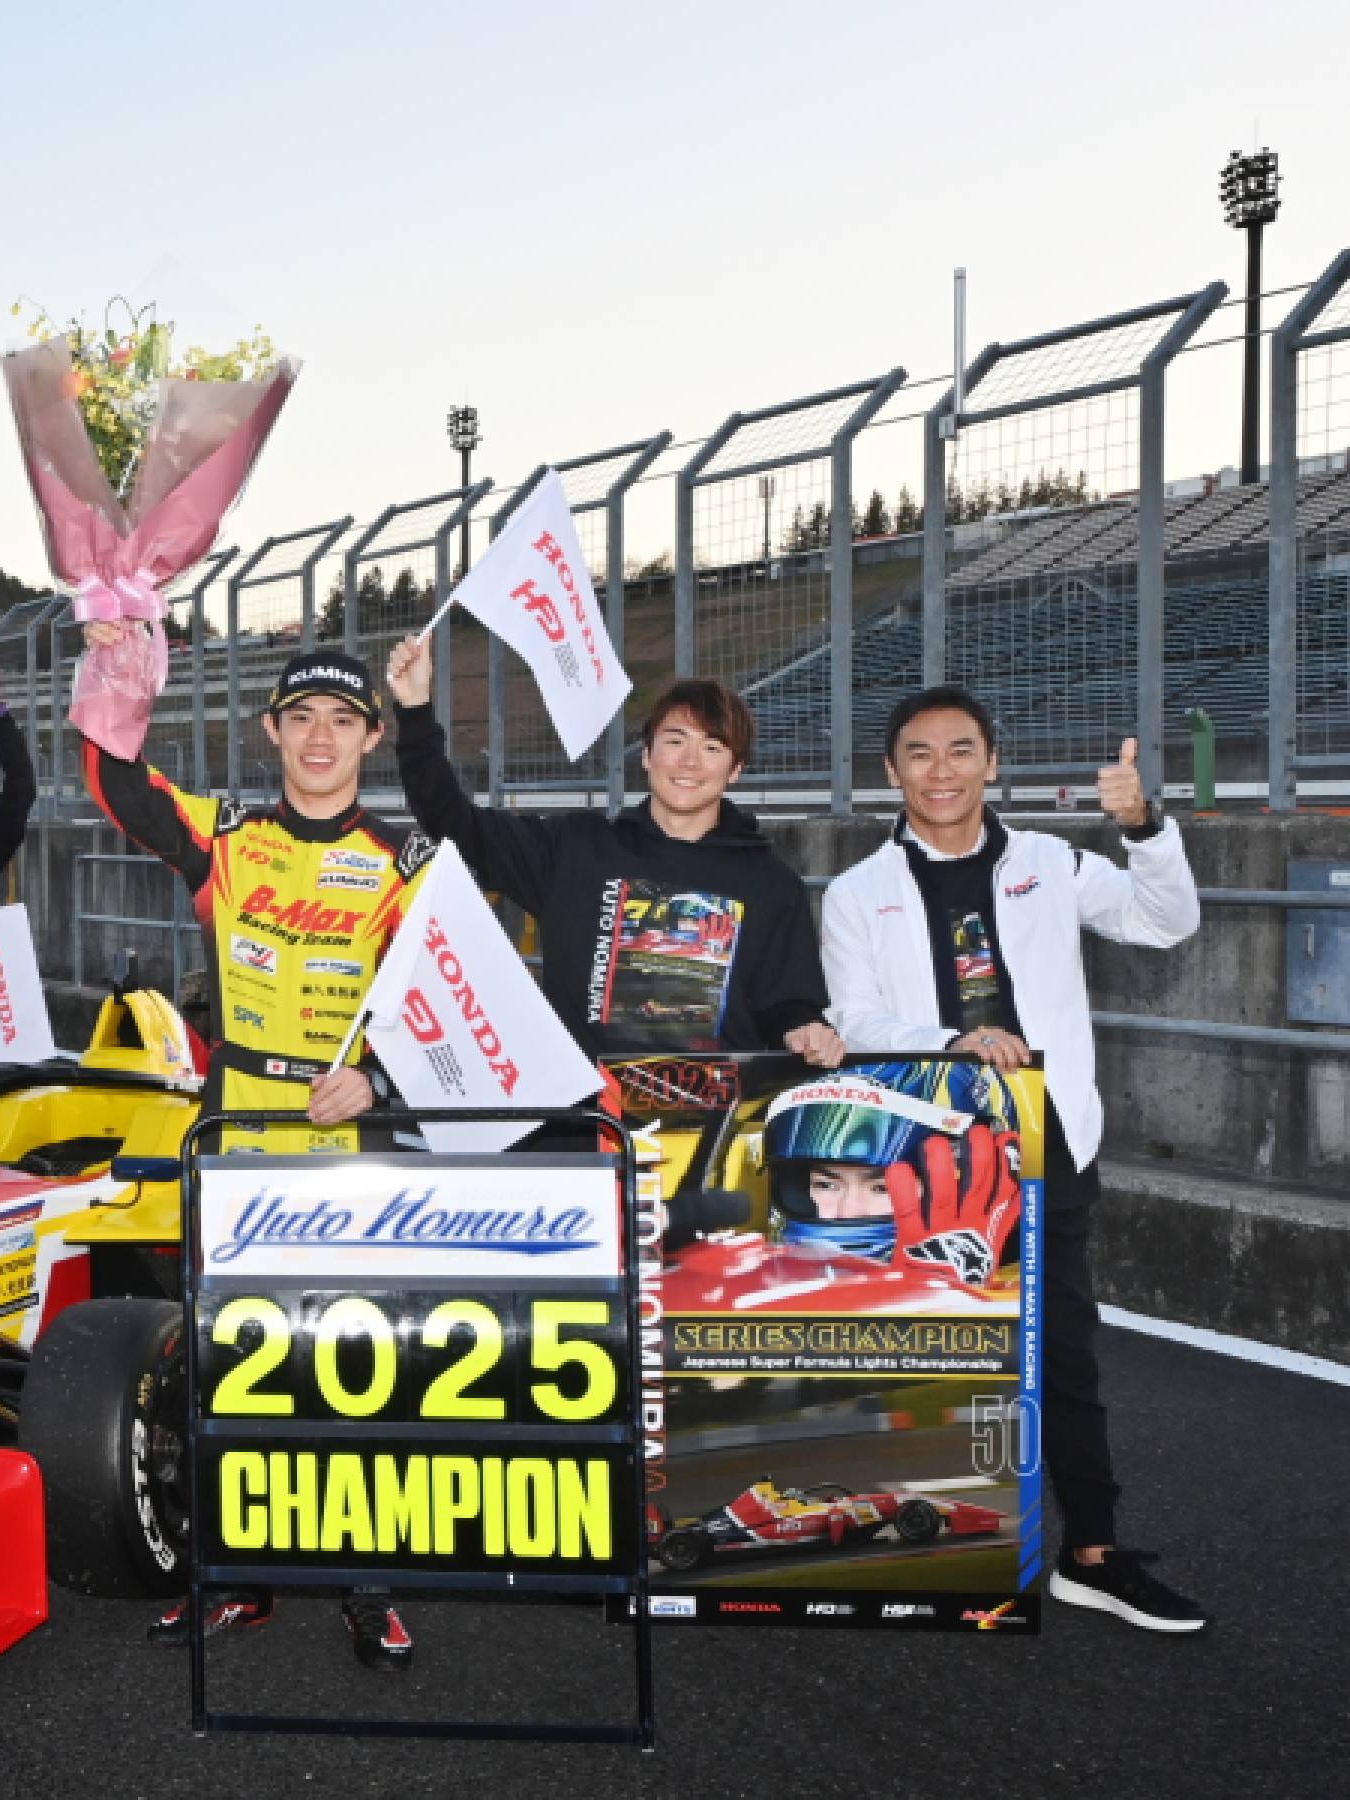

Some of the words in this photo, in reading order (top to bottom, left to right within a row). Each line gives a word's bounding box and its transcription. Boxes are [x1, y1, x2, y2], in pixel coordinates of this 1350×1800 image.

[532, 530, 604, 688] HONDA
[287, 665, 364, 691] KUMHO
[236, 911, 301, 945] Racing
[240, 885, 368, 934] B-Max
[602, 879, 622, 931] YUTO
[587, 935, 610, 1024] NOMURA
[791, 1087, 883, 1105] HONDA
[210, 1184, 353, 1263] Yuto
[364, 1185, 596, 1241] Nomura
[211, 1296, 617, 1420] 2025
[674, 1322, 805, 1353] SERIES
[806, 1322, 1010, 1353] CHAMPION
[681, 1356, 747, 1371] Japanese
[750, 1356, 791, 1371] Super
[794, 1357, 851, 1370] Formula
[854, 1357, 898, 1371] Lights
[900, 1357, 1003, 1371] Championship
[971, 1394, 1042, 1476] 50
[219, 1450, 613, 1561] CHAMPION
